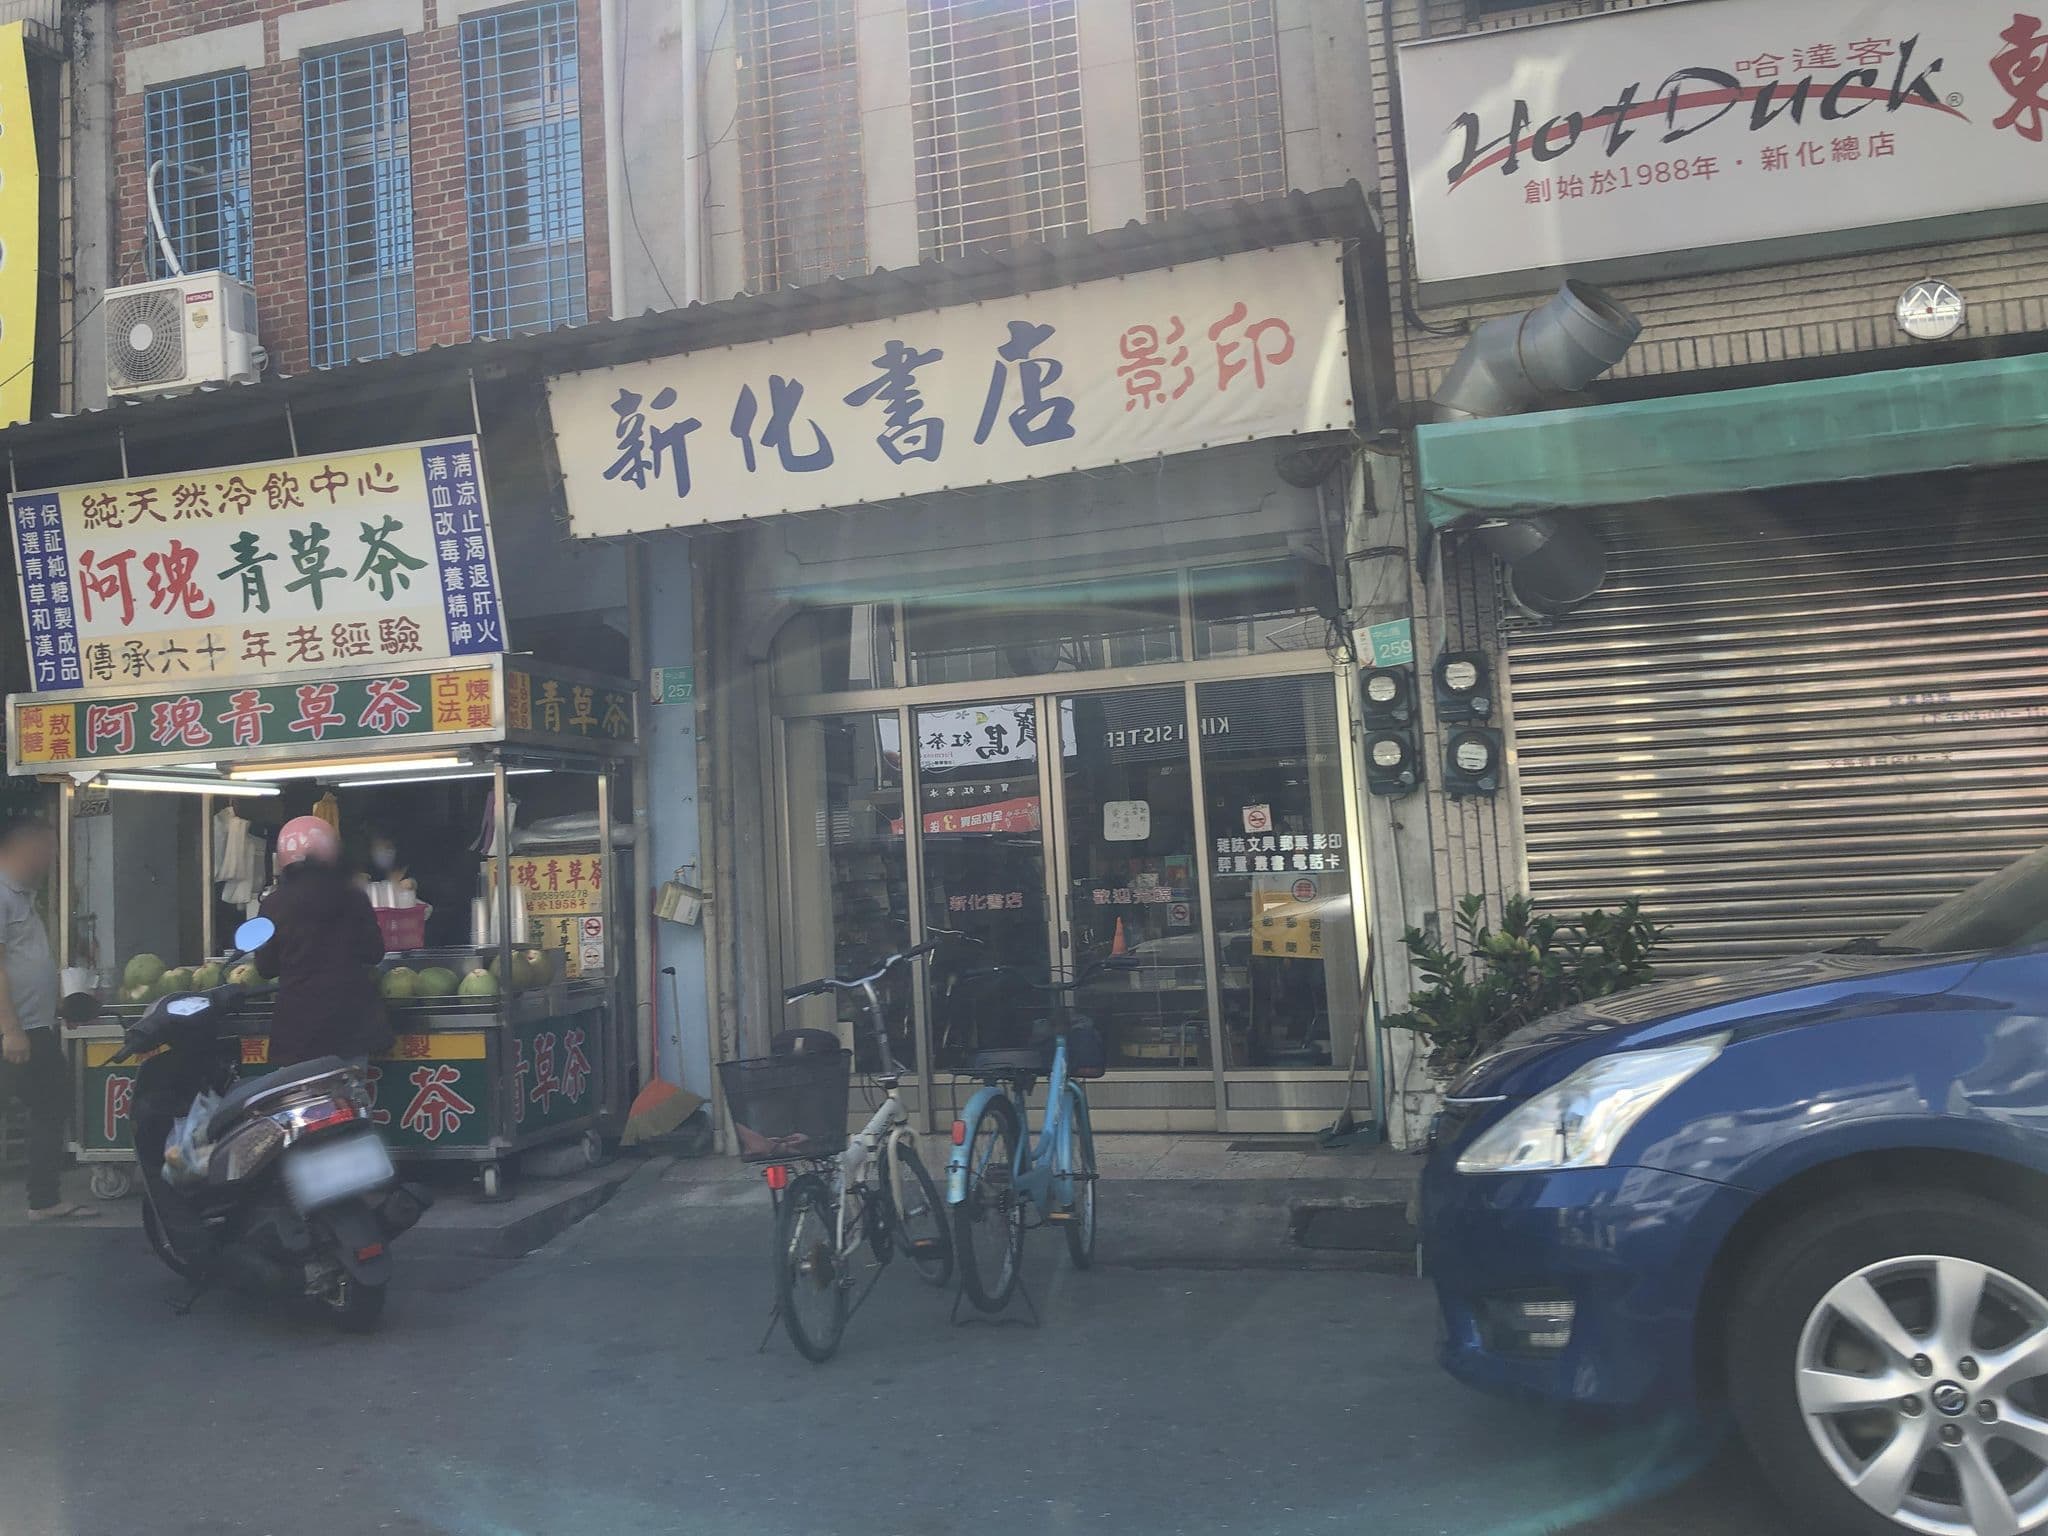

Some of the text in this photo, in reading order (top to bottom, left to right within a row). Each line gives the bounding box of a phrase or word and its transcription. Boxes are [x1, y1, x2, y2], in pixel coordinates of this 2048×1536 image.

[1736, 37, 1894, 79] 哈達客
[1524, 131, 1897, 205] 創始於1988年 新化總店
[603, 301, 1296, 499] 新化書店 影印
[82, 461, 401, 530] 純天然冷飲中心
[78, 514, 430, 627] 阿瑰青草茶
[451, 453, 499, 643] 清涼止渴退肝火
[41, 504, 81, 681] 保証純糖製成品
[85, 617, 424, 681] 傳承六十年老經驗
[1380, 639, 1413, 659] 259
[85, 682, 424, 754] 阿瑰青草茶
[437, 674, 462, 725] 古法
[465, 678, 492, 728] 煉製
[534, 680, 629, 739] 青草茶
[668, 685, 692, 698] 257
[1291, 853, 1340, 872] 電話卡
[948, 891, 1023, 912] 新化書店
[240, 1038, 268, 1063] 煮
